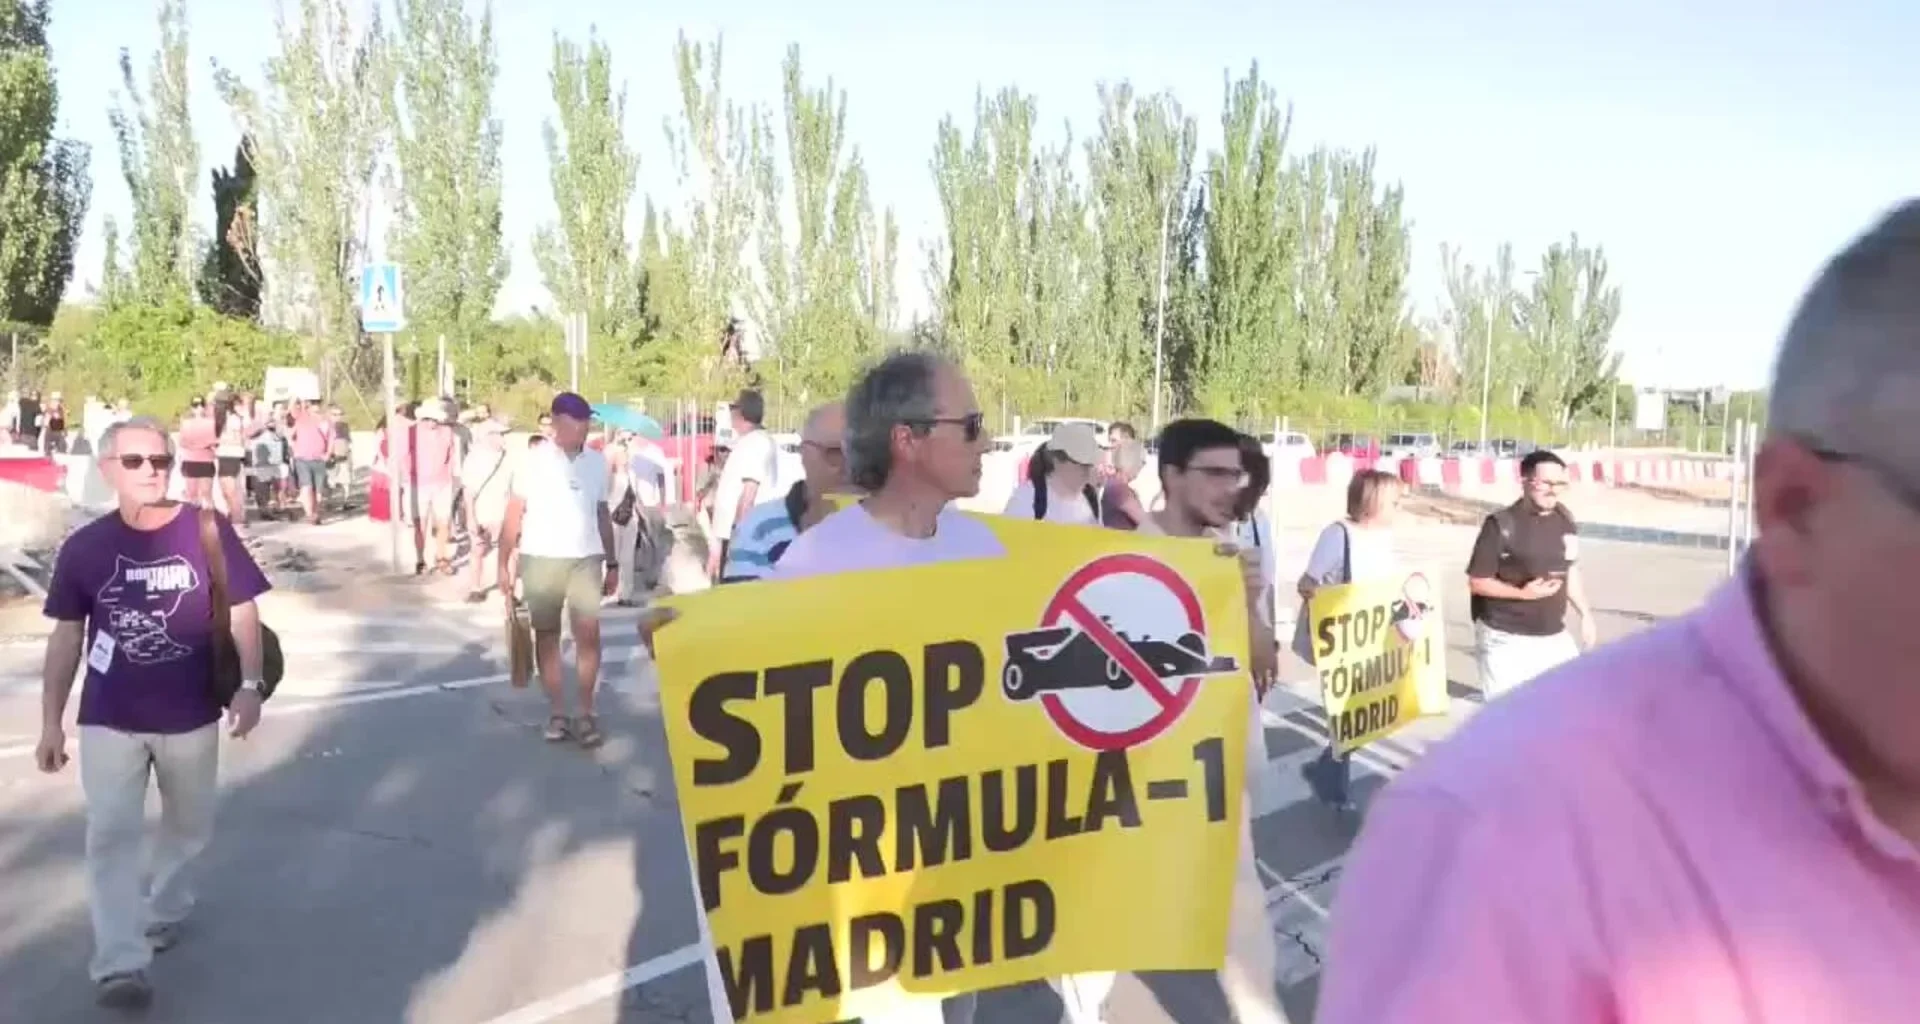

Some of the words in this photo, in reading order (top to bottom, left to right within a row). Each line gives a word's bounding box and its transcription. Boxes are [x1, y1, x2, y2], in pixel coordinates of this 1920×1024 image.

[1318, 605, 1385, 657] STOP
[687, 639, 985, 786] STOP
[695, 736, 1228, 910] FÓRMULA-1
[716, 879, 1056, 1022] MADRID
